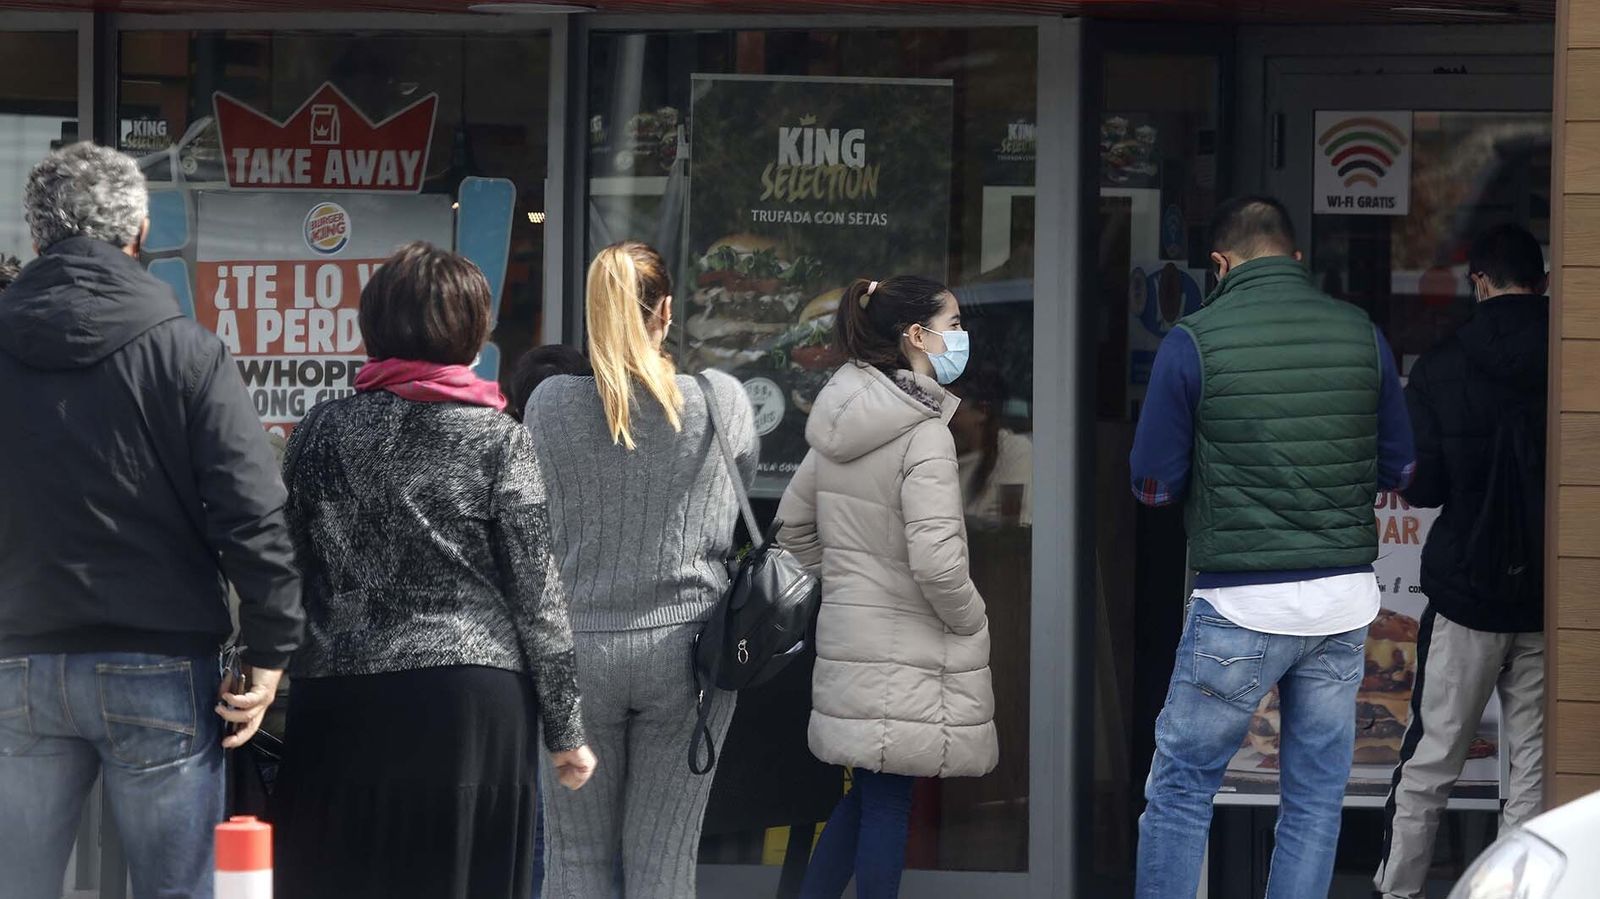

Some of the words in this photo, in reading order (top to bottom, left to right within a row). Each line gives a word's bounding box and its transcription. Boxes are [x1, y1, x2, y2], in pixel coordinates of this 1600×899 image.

[133, 120, 167, 136] KING
[777, 127, 866, 168] KING
[232, 148, 311, 184] TAKE
[324, 149, 421, 186] AWAY
[760, 162, 881, 203] SELECTION
[1327, 195, 1354, 208] WI-FI
[1357, 196, 1395, 208] GRATIS
[311, 213, 344, 229] BURGER
[311, 222, 345, 242] KING
[751, 209, 811, 224] TRUFADA
[814, 211, 845, 225] CON
[848, 212, 888, 226] SETAS
[214, 265, 277, 309] ¿TE
[294, 264, 343, 309] LO
[217, 310, 241, 353] A
[256, 308, 362, 354] PERD
